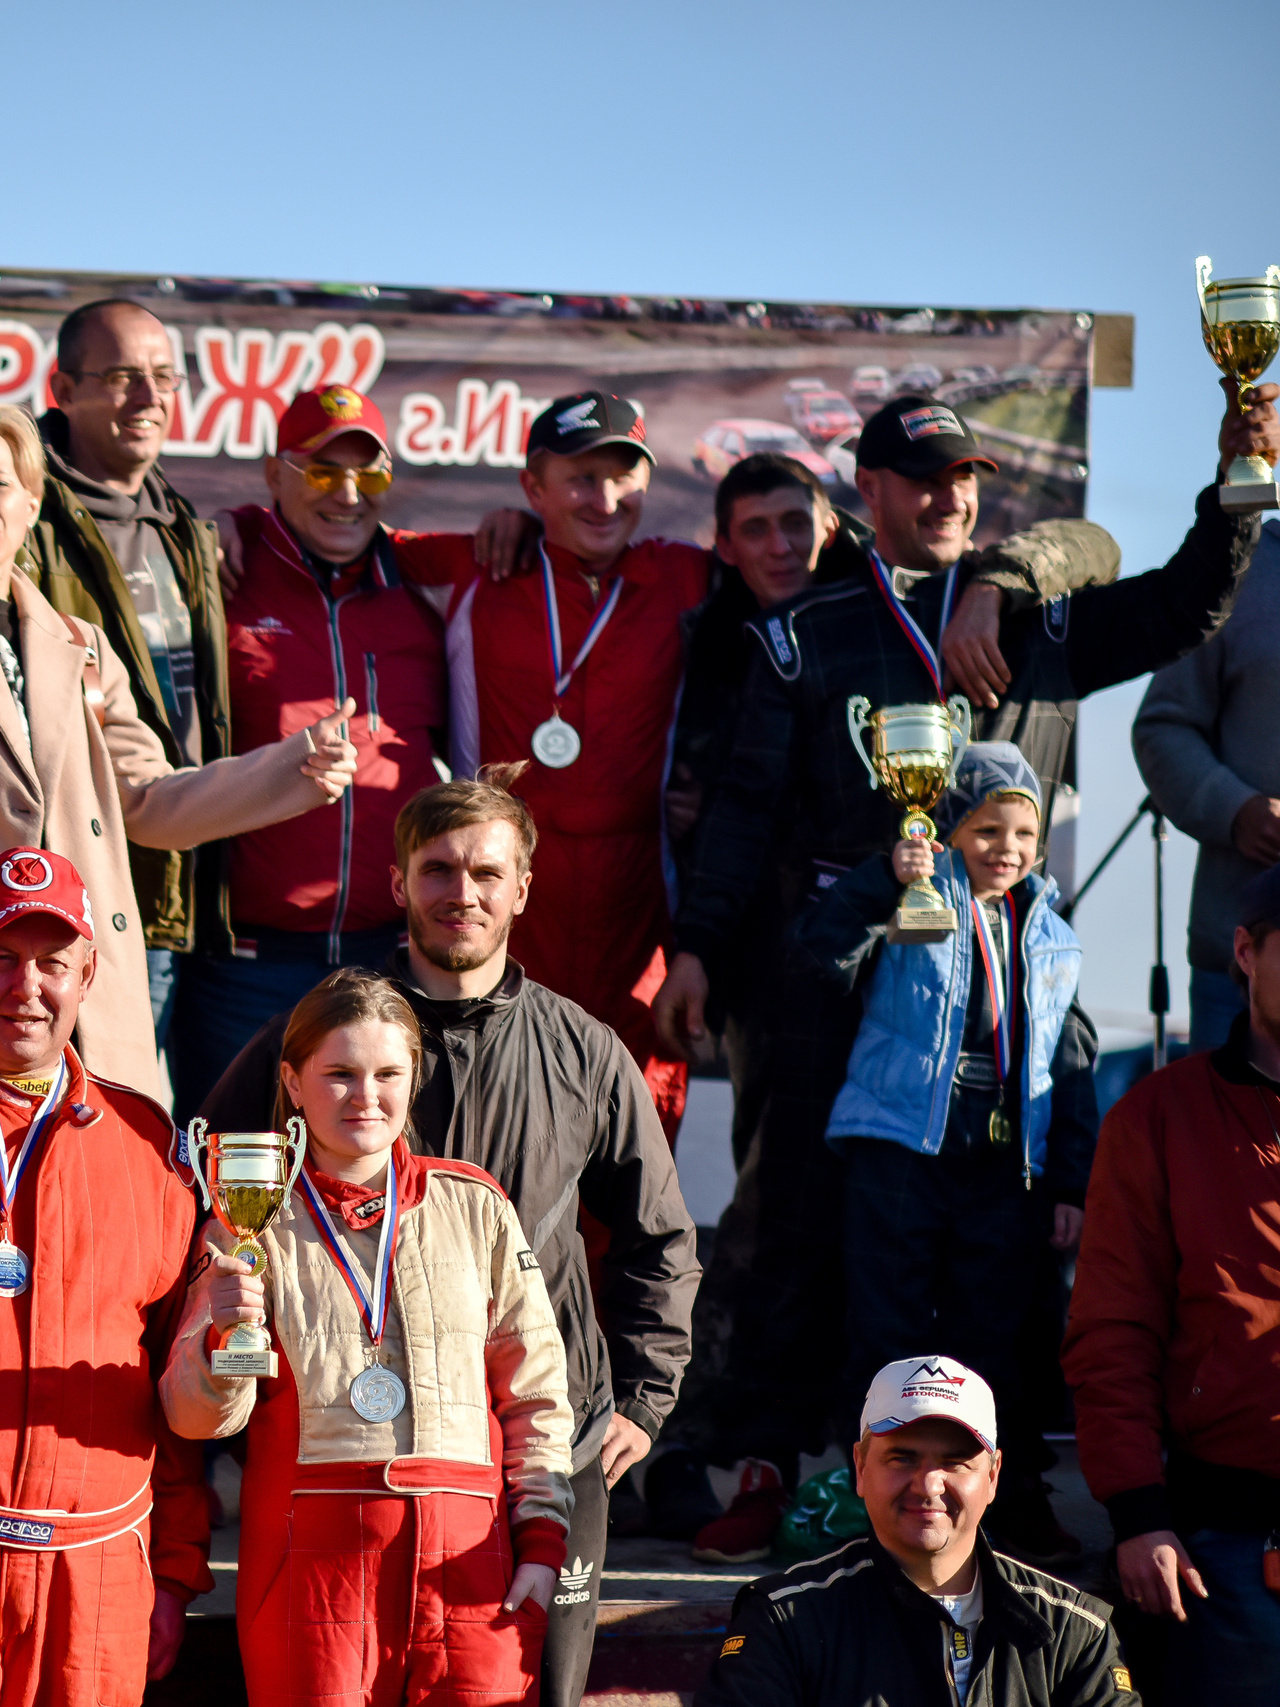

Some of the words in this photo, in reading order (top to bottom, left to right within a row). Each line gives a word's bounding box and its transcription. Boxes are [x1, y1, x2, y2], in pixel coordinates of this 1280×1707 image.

[368, 1383, 389, 1406] 2
[901, 1391, 960, 1403] АВТОКРОСС
[554, 1590, 591, 1605] adidas
[721, 1639, 744, 1653] OMP
[954, 1631, 967, 1659] OMP
